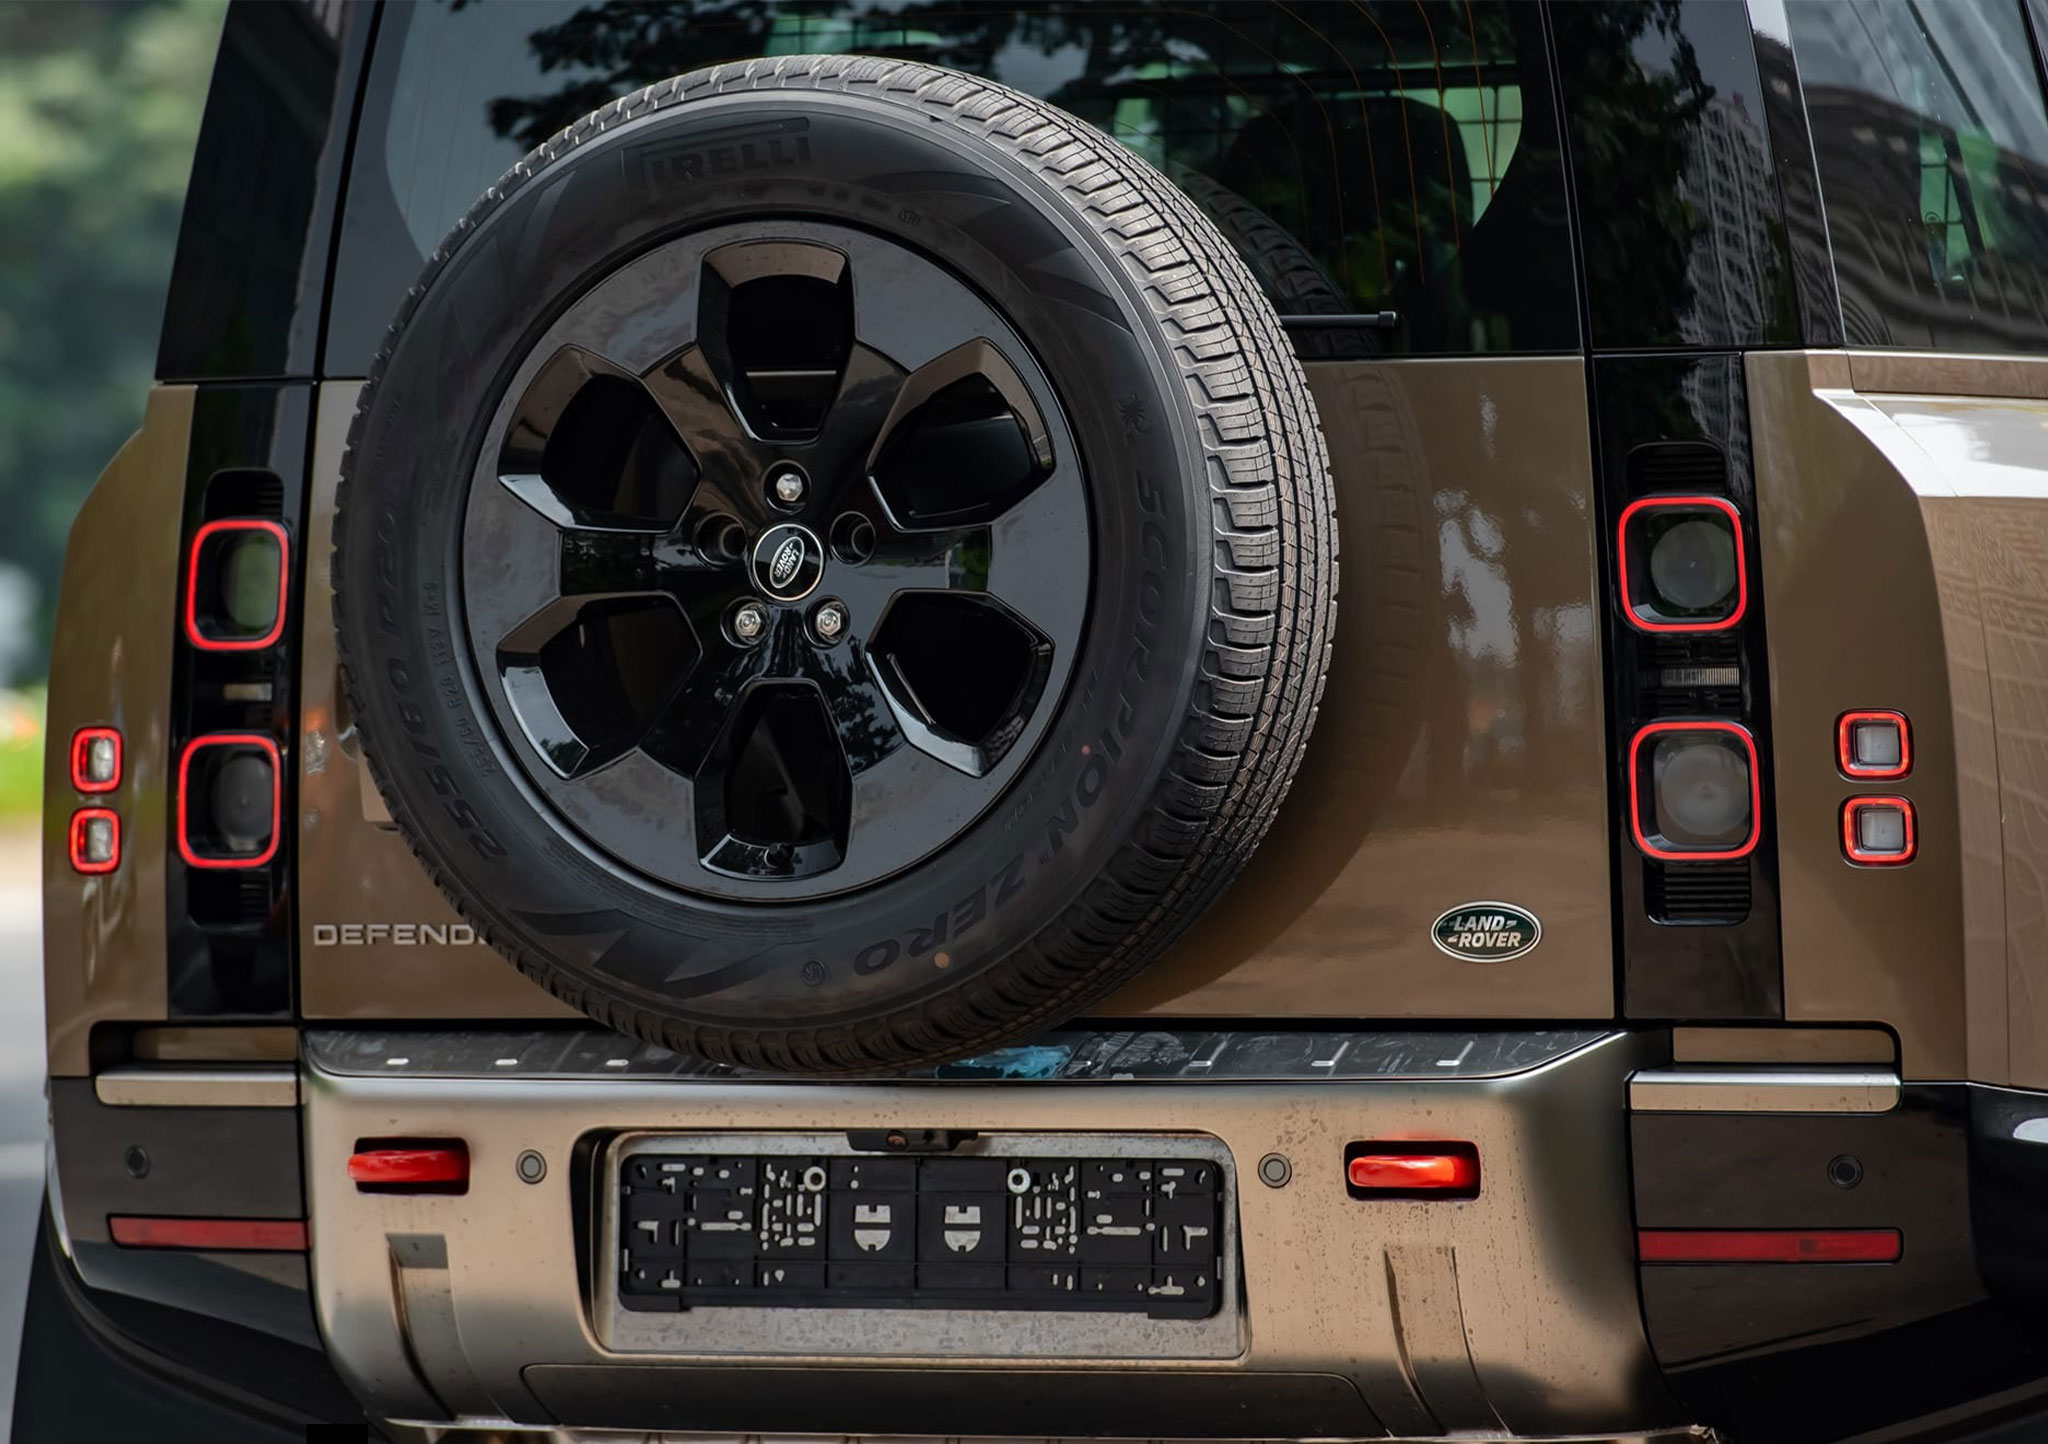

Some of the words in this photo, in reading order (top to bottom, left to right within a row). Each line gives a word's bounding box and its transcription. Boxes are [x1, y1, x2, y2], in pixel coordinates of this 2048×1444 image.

[621, 115, 811, 186] PIRELLI
[1043, 467, 1168, 853] SCORPION
[387, 657, 508, 861] 255/60
[313, 923, 488, 946] DEFEND
[853, 853, 1027, 977] ZERO
[1453, 915, 1505, 931] LAND
[1458, 931, 1521, 948] ROVER
